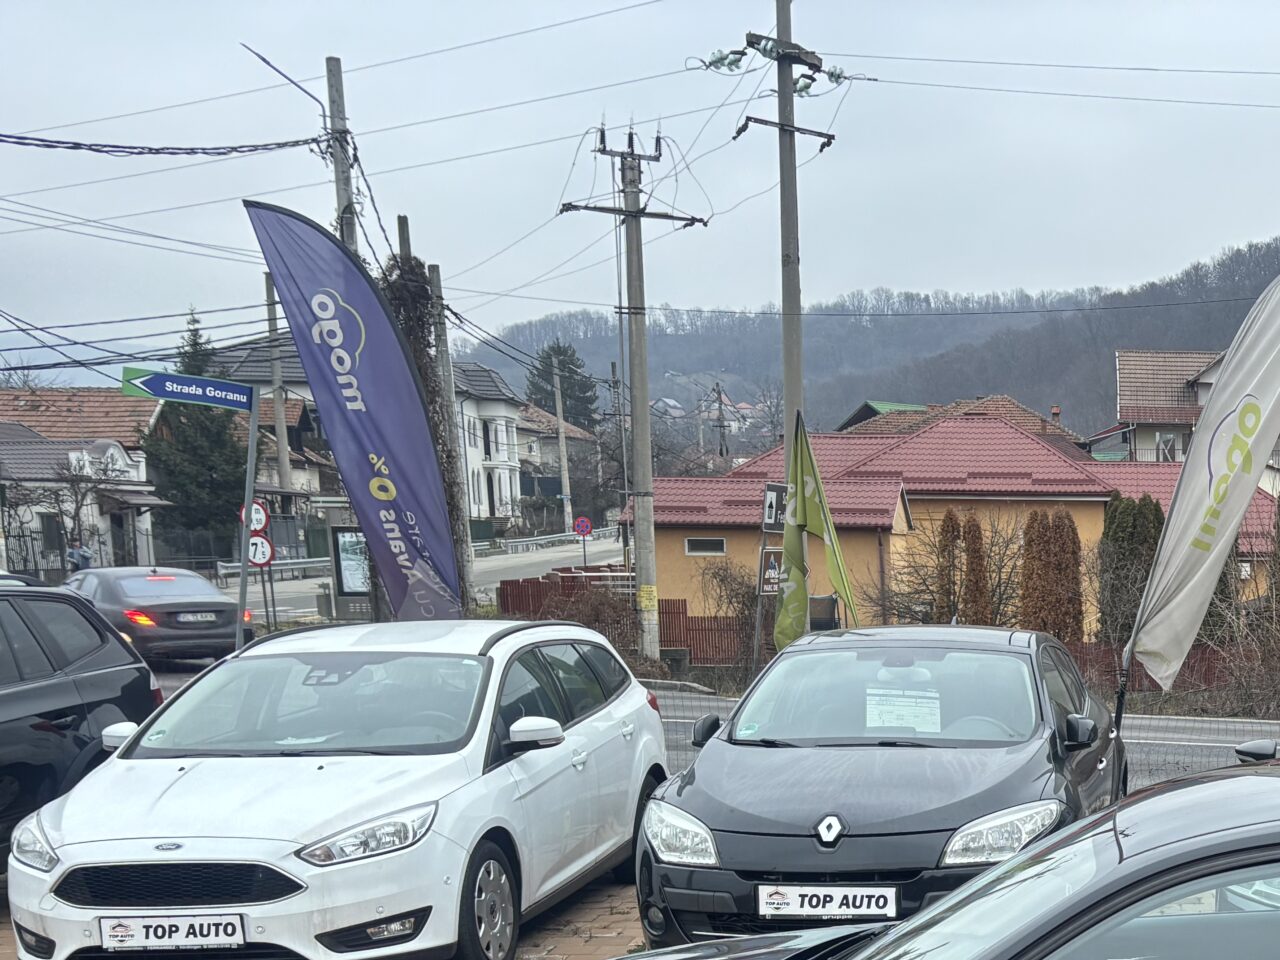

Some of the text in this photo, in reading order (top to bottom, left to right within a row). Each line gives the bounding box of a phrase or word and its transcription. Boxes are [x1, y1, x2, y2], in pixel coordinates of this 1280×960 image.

[165, 381, 247, 402] Strada Goranu
[798, 894, 888, 909] TOP AUTO
[142, 922, 237, 940] TOP AUTO
